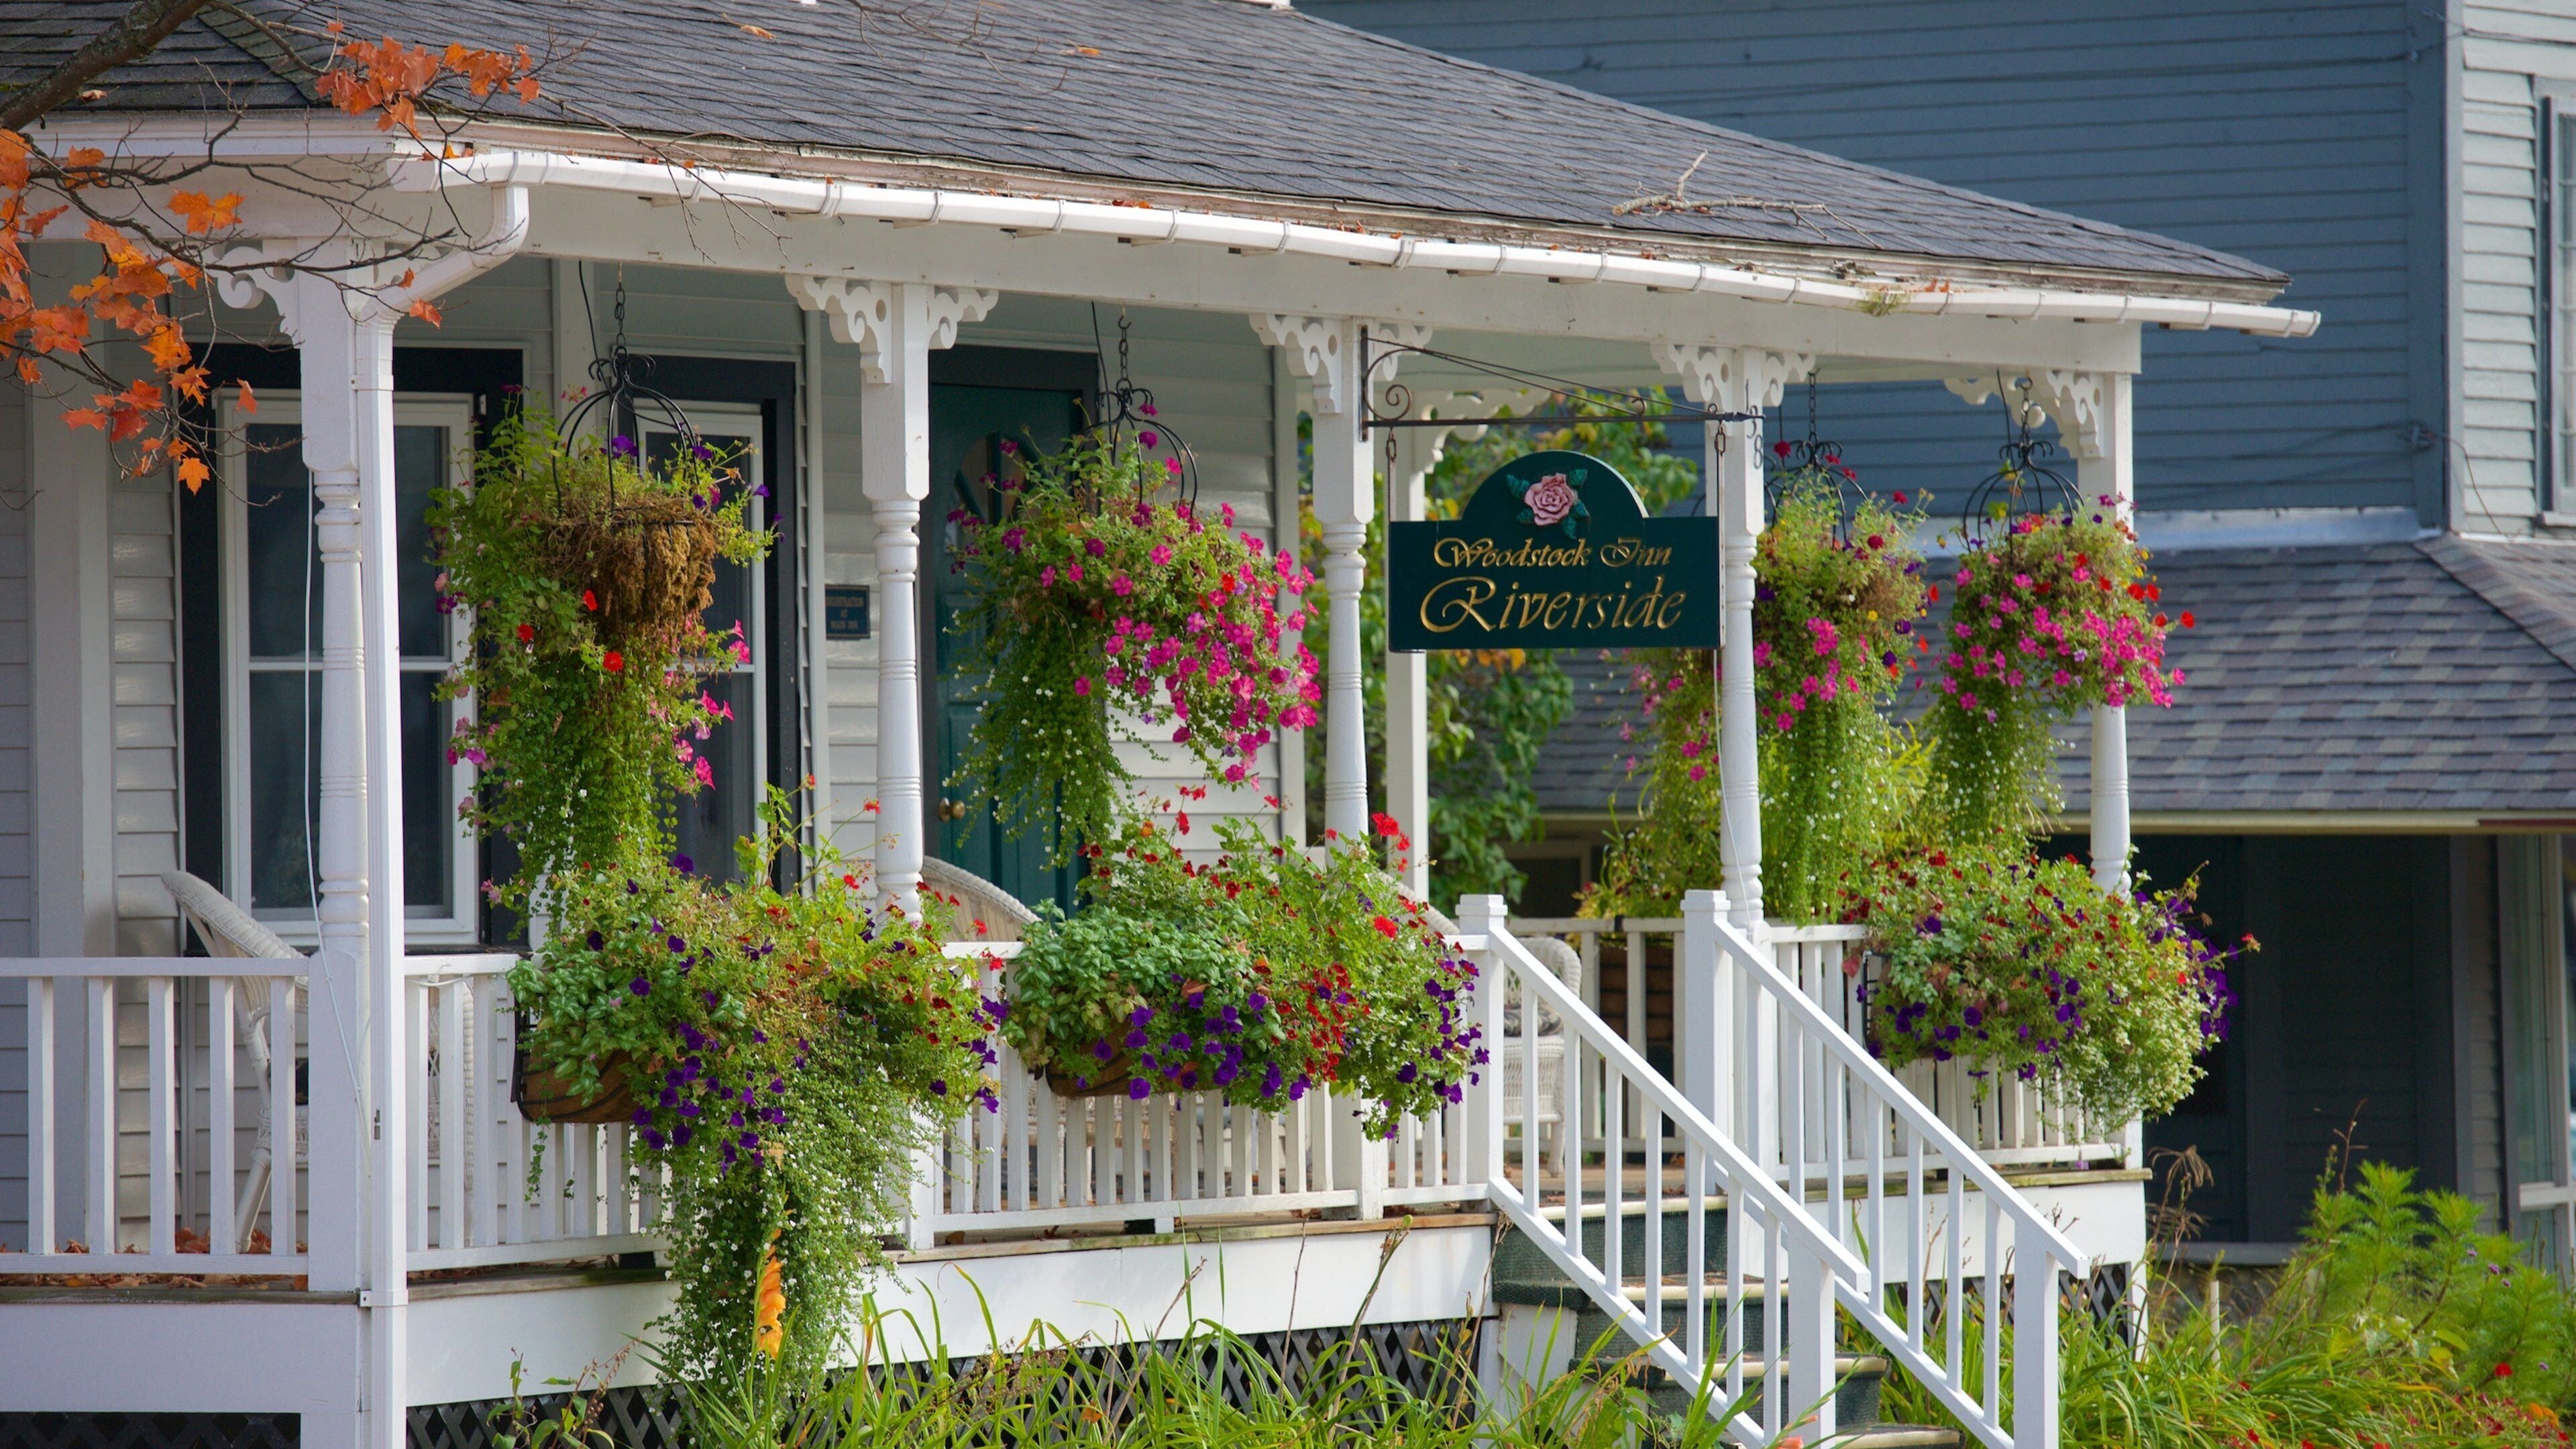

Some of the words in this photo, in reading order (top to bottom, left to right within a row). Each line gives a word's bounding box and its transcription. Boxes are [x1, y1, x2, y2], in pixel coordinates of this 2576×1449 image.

[1434, 537, 1593, 568] Woodstock
[1600, 537, 1672, 568] Inn
[1420, 573, 1687, 633] Riverside
